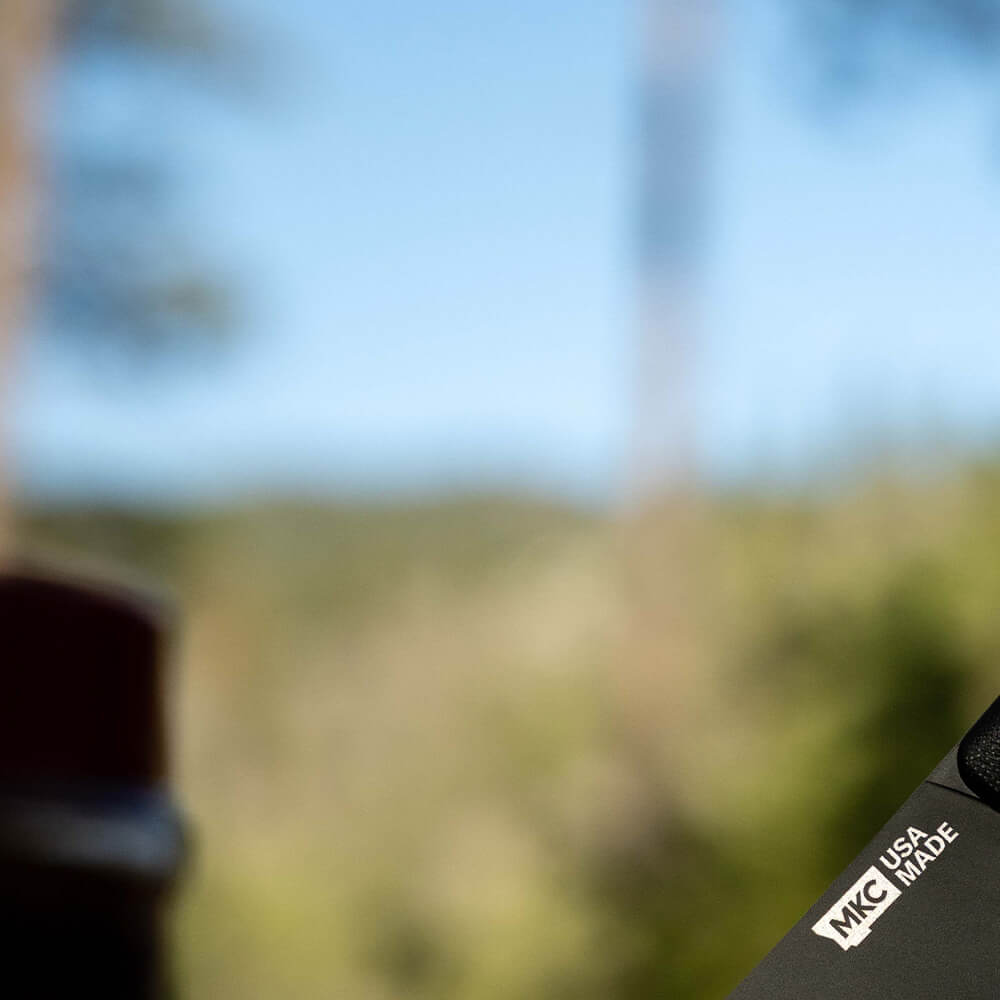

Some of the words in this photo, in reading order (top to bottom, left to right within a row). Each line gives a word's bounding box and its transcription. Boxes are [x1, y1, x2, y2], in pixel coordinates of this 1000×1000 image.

[880, 826, 928, 870] USA
[894, 821, 960, 887] MADE
[829, 880, 887, 938] MKC
